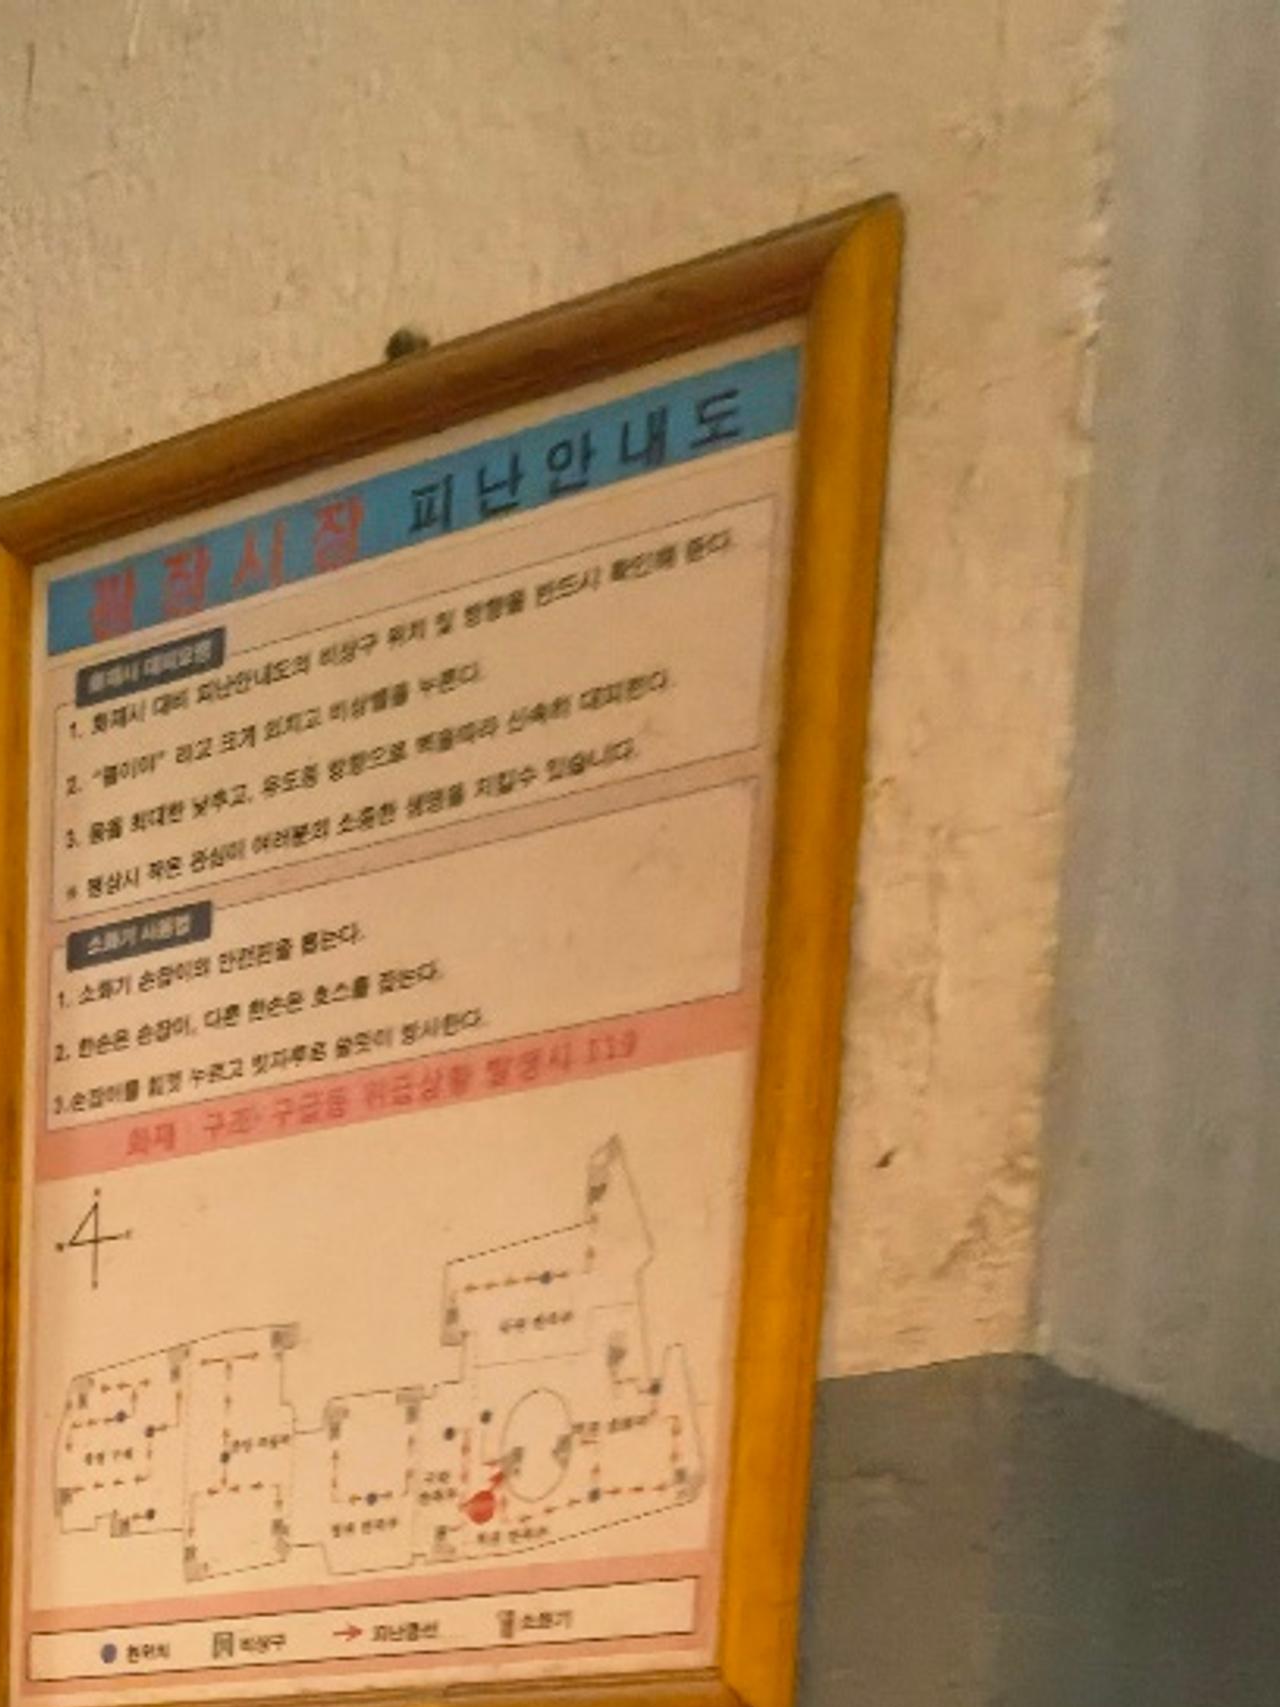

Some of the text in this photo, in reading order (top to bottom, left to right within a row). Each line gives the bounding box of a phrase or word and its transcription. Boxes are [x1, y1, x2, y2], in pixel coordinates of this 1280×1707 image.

[409, 388, 739, 534] 피난안내도
[91, 708, 146, 735] 화재시
[197, 654, 310, 704] 피난안내도의
[318, 633, 378, 666] 비상구
[386, 618, 427, 647] 위치
[435, 609, 456, 636] 및
[535, 566, 601, 607] 반드시
[175, 737, 212, 764] 라고
[220, 725, 257, 750] 크게
[263, 706, 323, 733] 외치고
[329, 681, 410, 721] 비상벨을
[88, 815, 124, 846] 몸을
[130, 800, 186, 833] 최대한
[262, 764, 319, 797] 유도등
[327, 740, 408, 783] 방향으로
[507, 694, 573, 735] 신속히
[88, 871, 141, 900] 평상시
[147, 855, 183, 881] 작은
[191, 839, 246, 874] 관심이
[251, 817, 331, 854] 여러분의
[336, 801, 397, 836] 소중한
[406, 781, 464, 819] 생명을
[78, 976, 132, 1005] 소화기
[138, 957, 212, 993] 손잡이의
[218, 938, 293, 975] 안전핀을
[78, 1029, 131, 1058] 한손은
[203, 1003, 240, 1029] 다른
[247, 991, 305, 1023] 한손은
[311, 975, 370, 1008] 호스를
[190, 1058, 244, 1089] 누르고
[251, 1042, 327, 1075] 빗자루로
[238, 1632, 289, 1656] 비상구
[520, 1608, 574, 1632] 소화기
